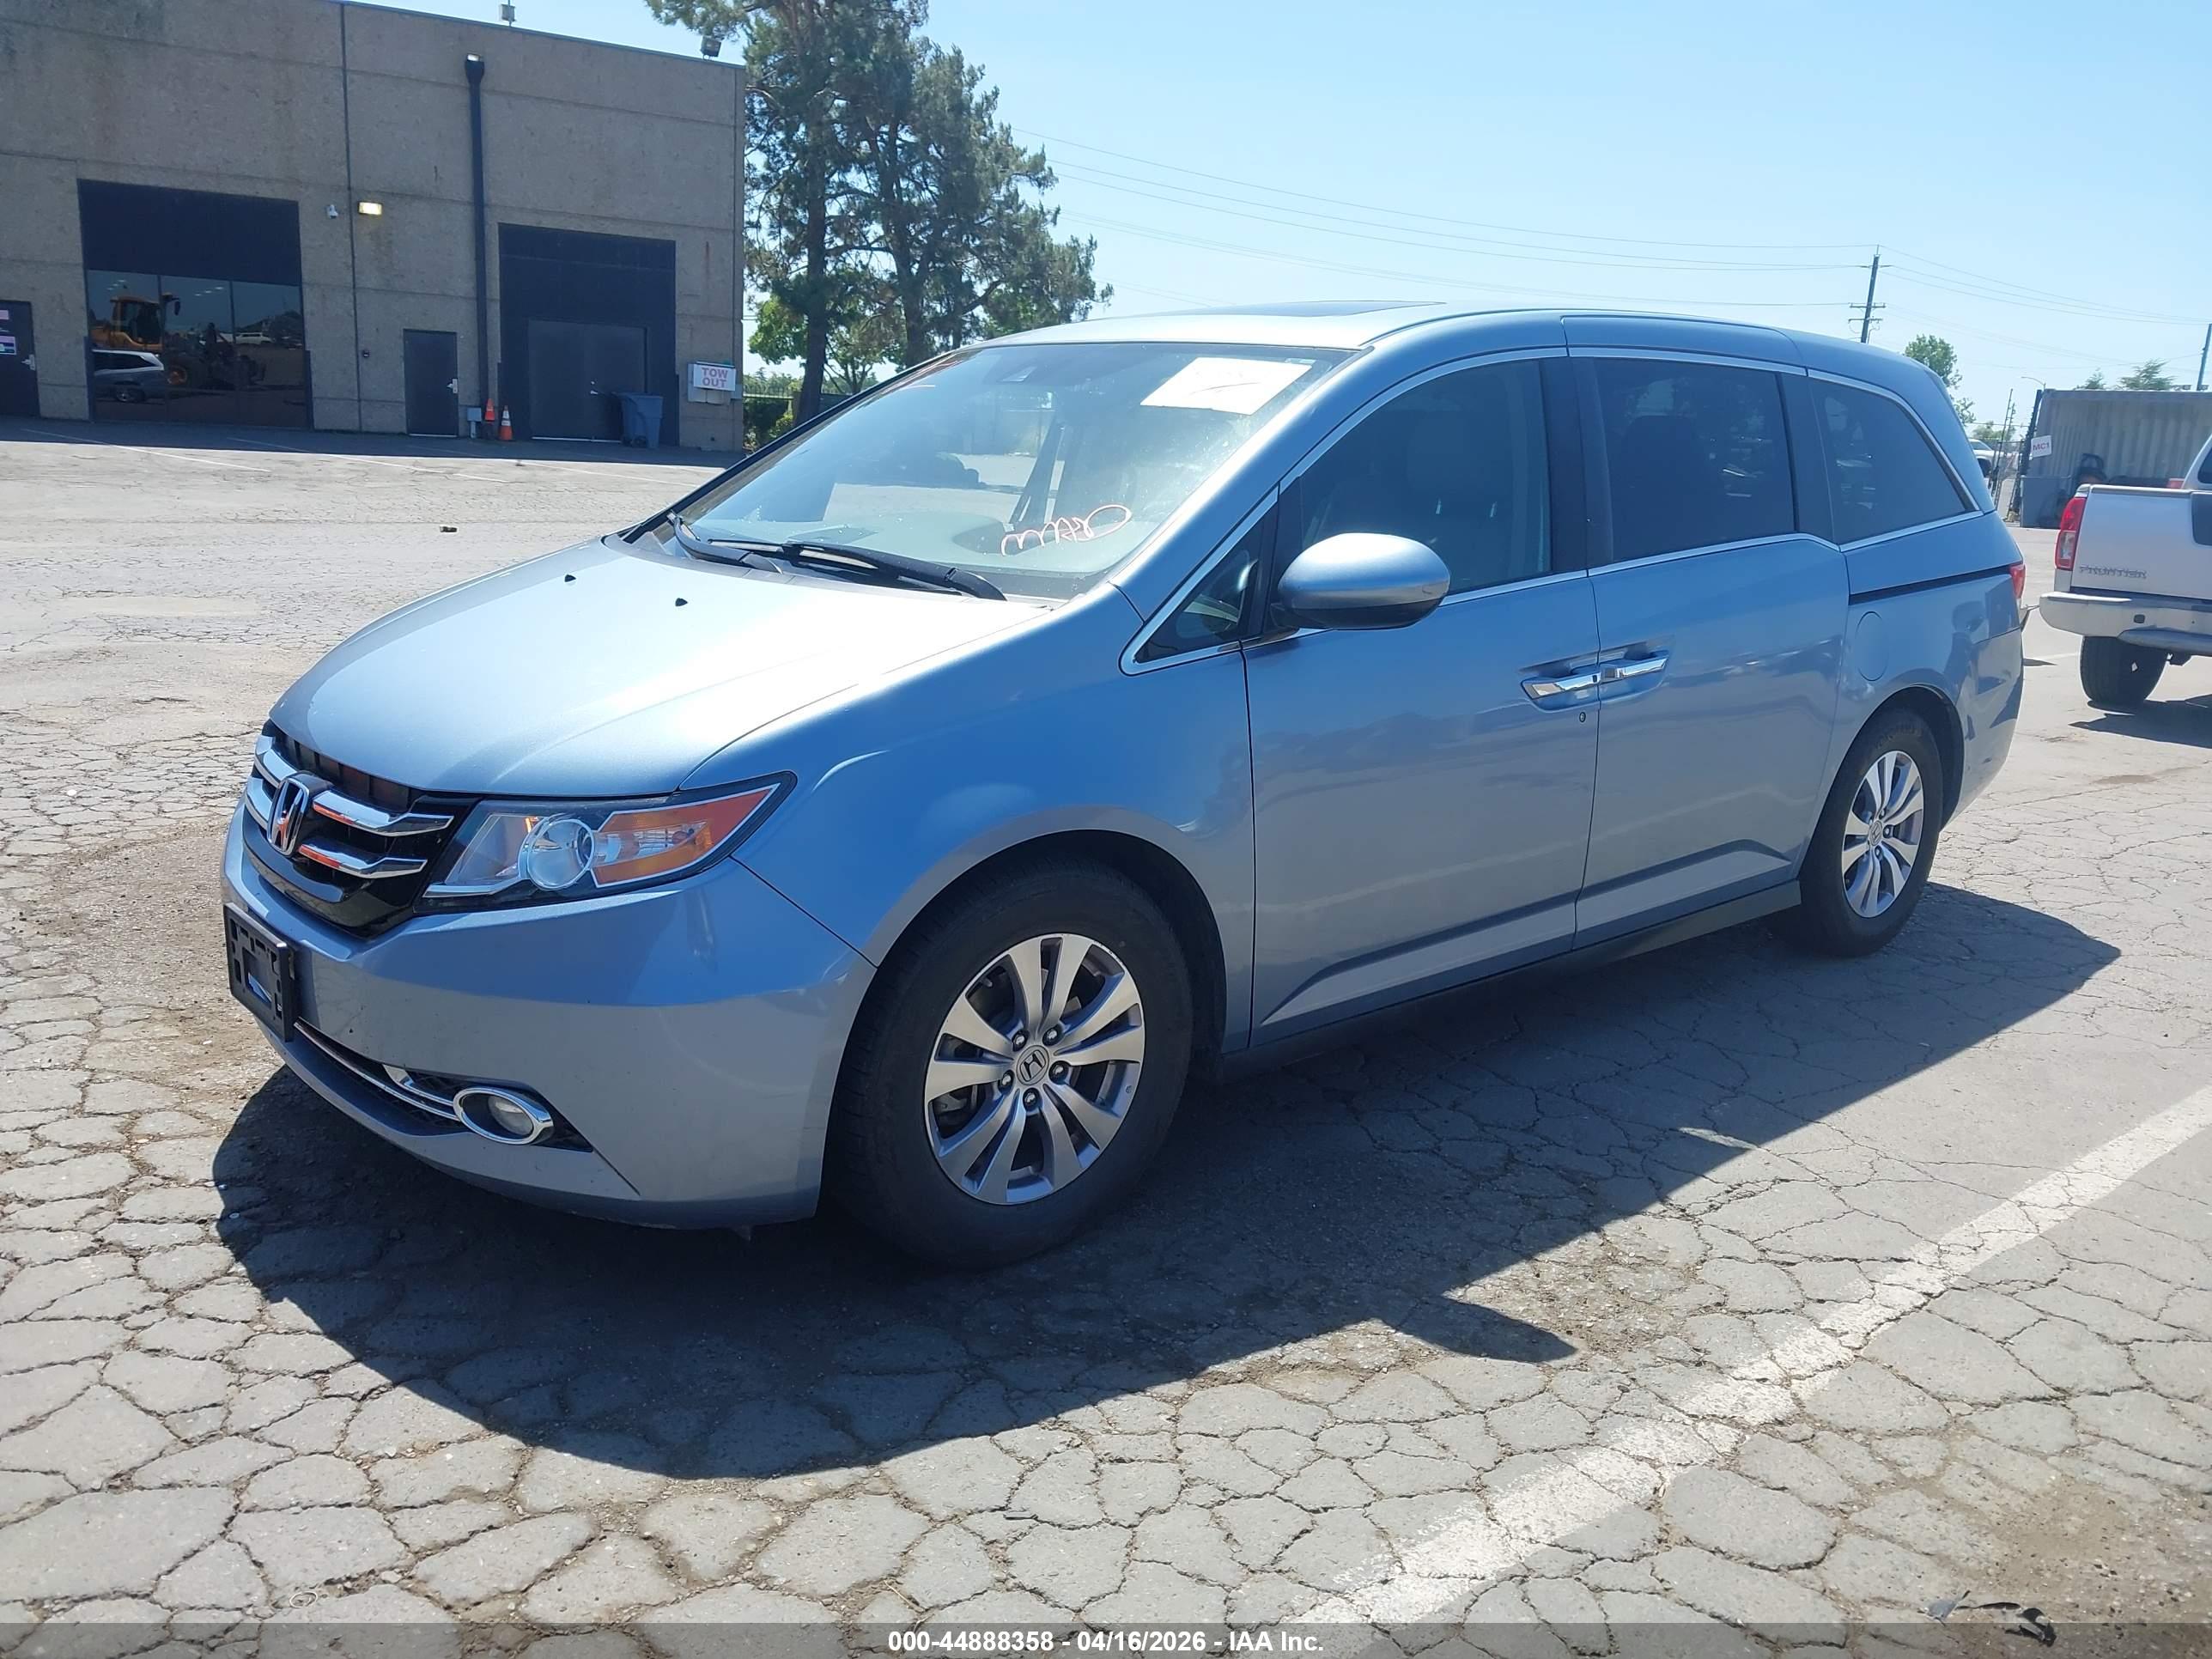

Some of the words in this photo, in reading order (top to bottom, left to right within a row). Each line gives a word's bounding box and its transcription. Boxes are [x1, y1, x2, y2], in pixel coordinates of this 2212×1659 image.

[701, 367, 728, 379] TOW
[702, 377, 727, 388] OUT
[2079, 564, 2147, 579] FRONTIER
